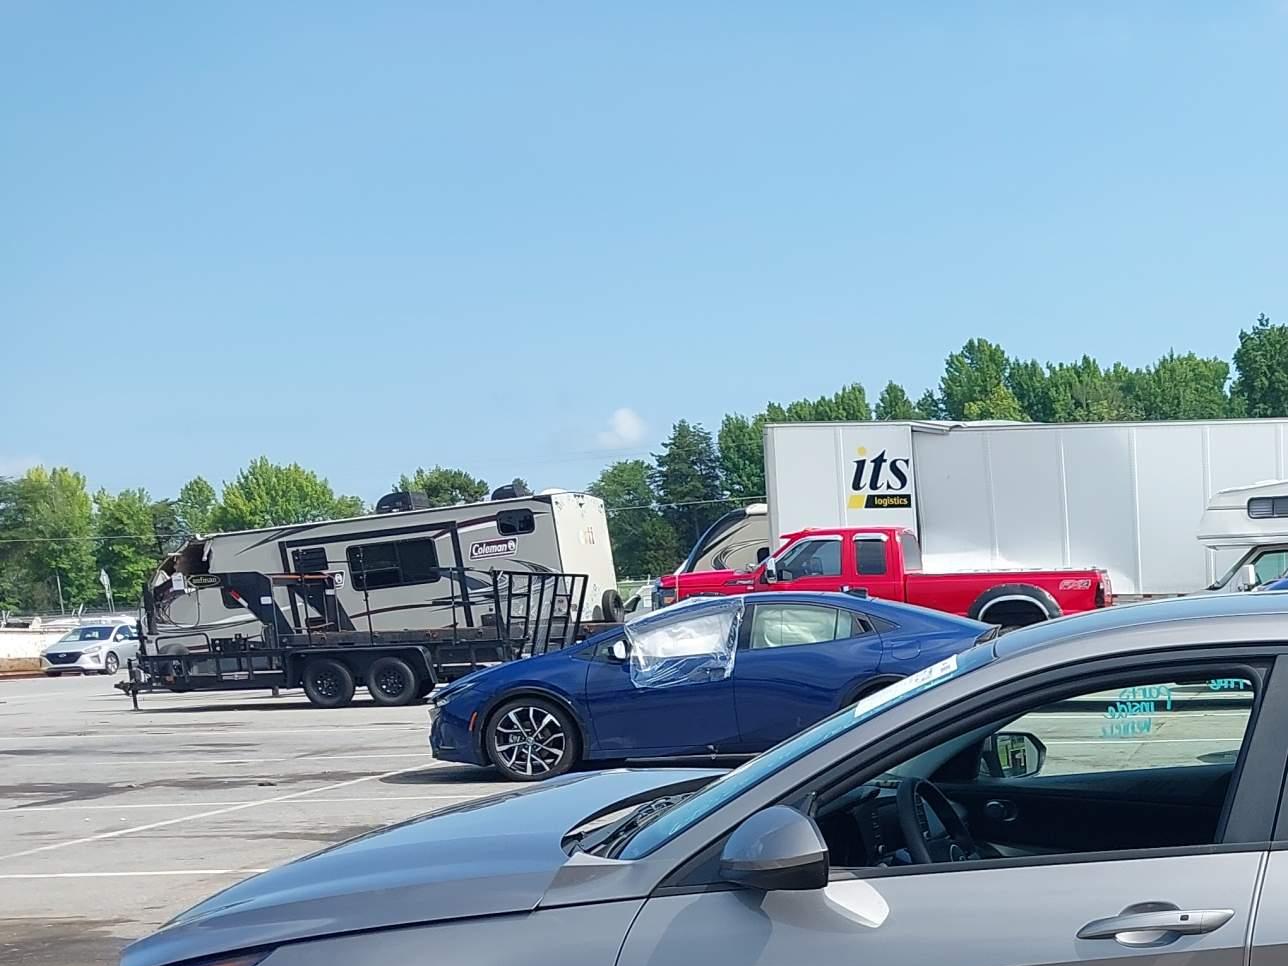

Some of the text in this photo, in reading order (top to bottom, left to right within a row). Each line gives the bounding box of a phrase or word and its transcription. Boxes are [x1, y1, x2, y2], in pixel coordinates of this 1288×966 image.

[851, 446, 910, 491] its
[874, 496, 909, 507] logistics
[472, 542, 508, 557] Coleman
